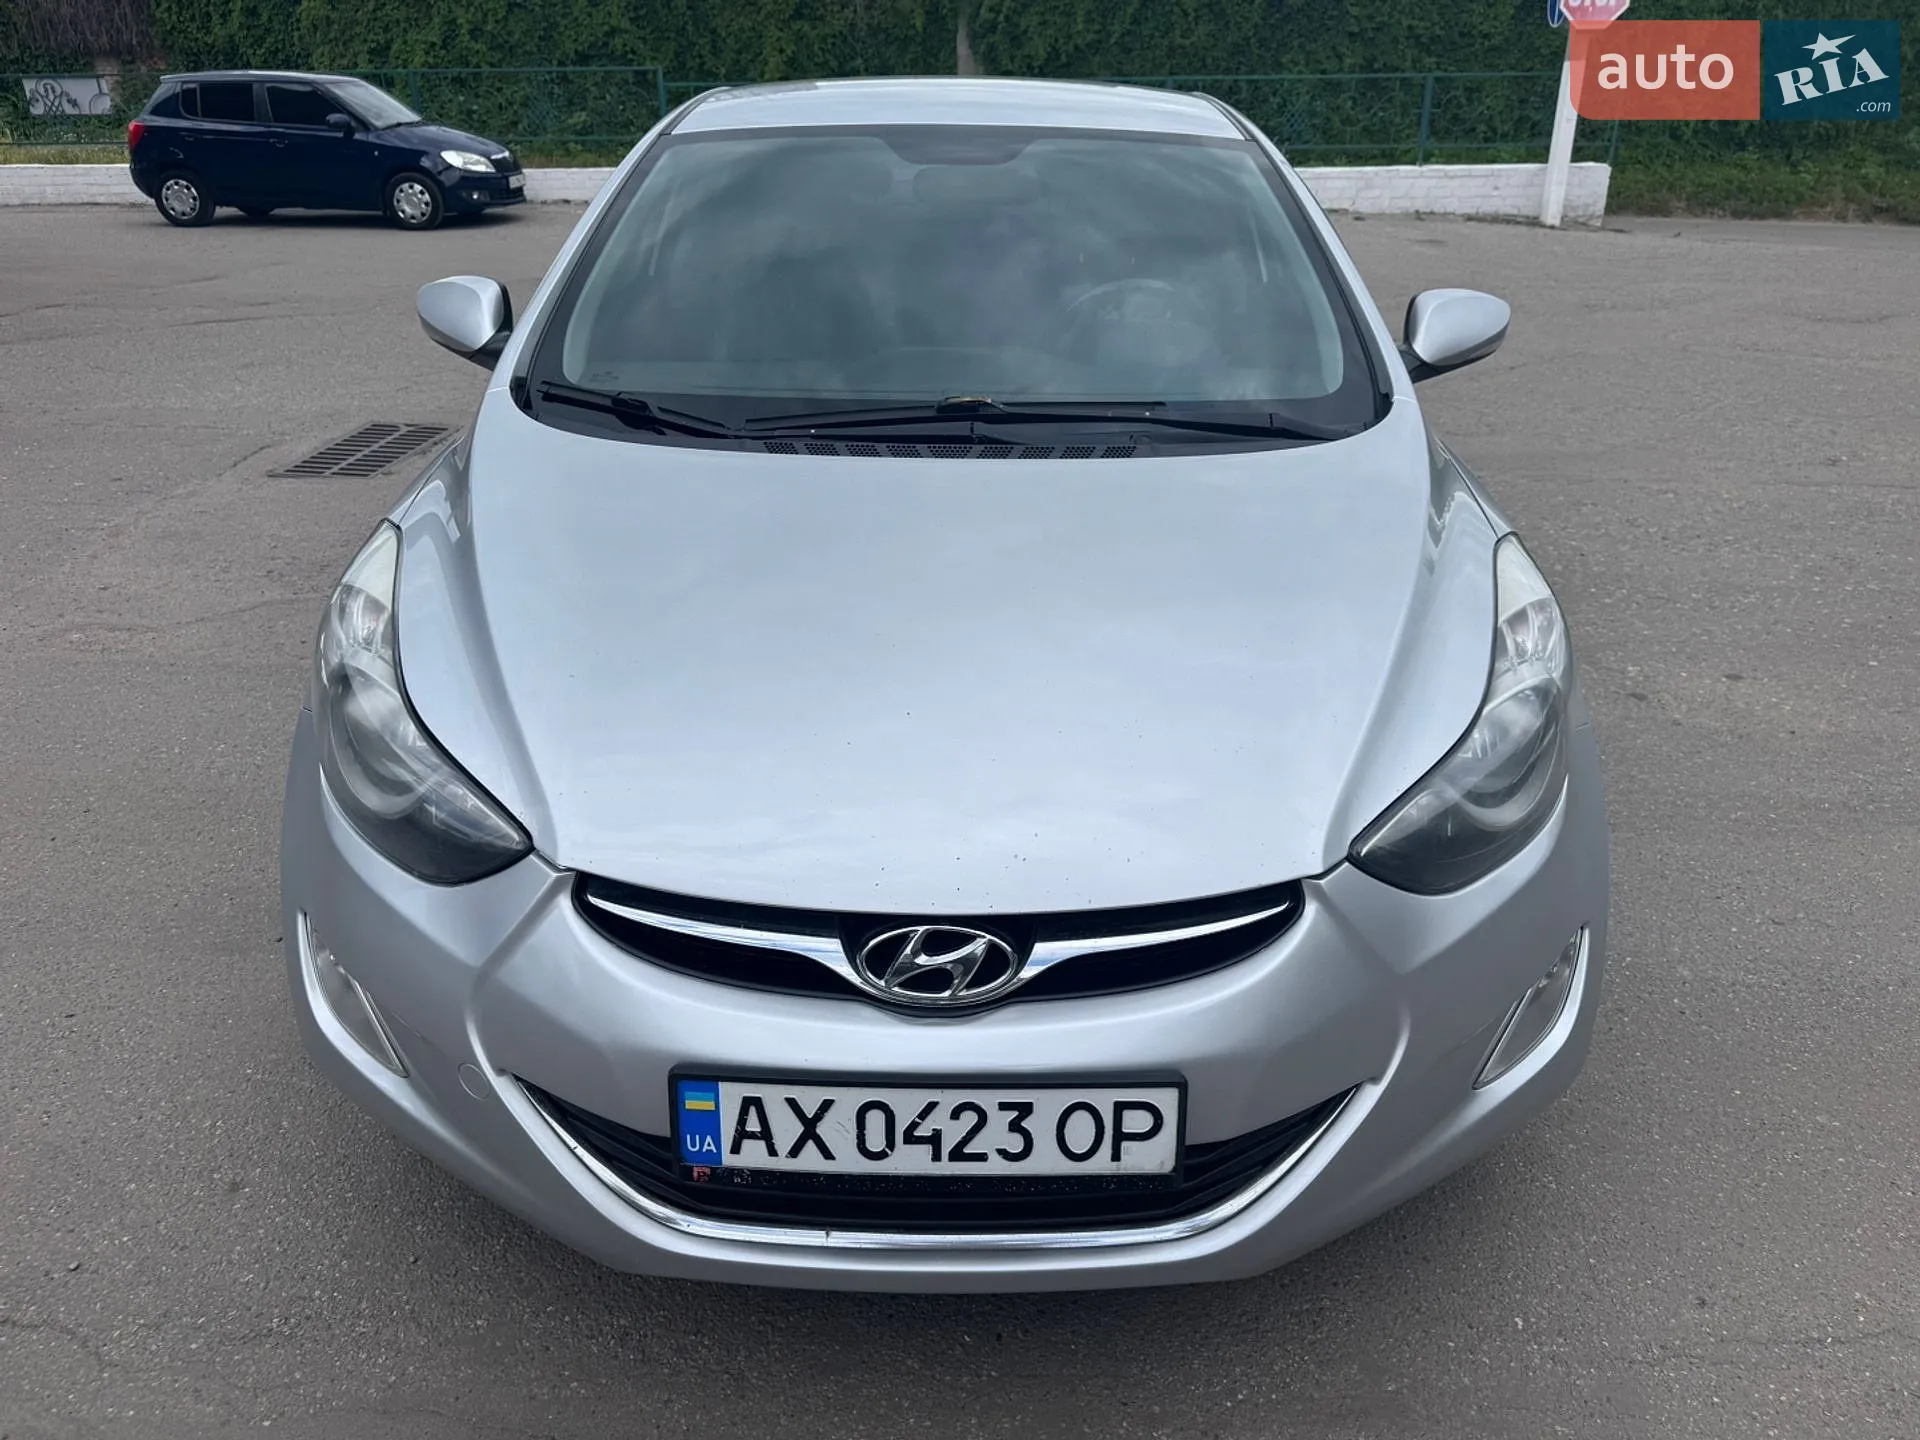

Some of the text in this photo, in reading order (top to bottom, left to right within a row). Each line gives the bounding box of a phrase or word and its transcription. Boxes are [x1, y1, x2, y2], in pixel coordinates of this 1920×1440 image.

[686, 1133, 717, 1153] UA
[729, 1095, 1164, 1163] AX 0423 OP
